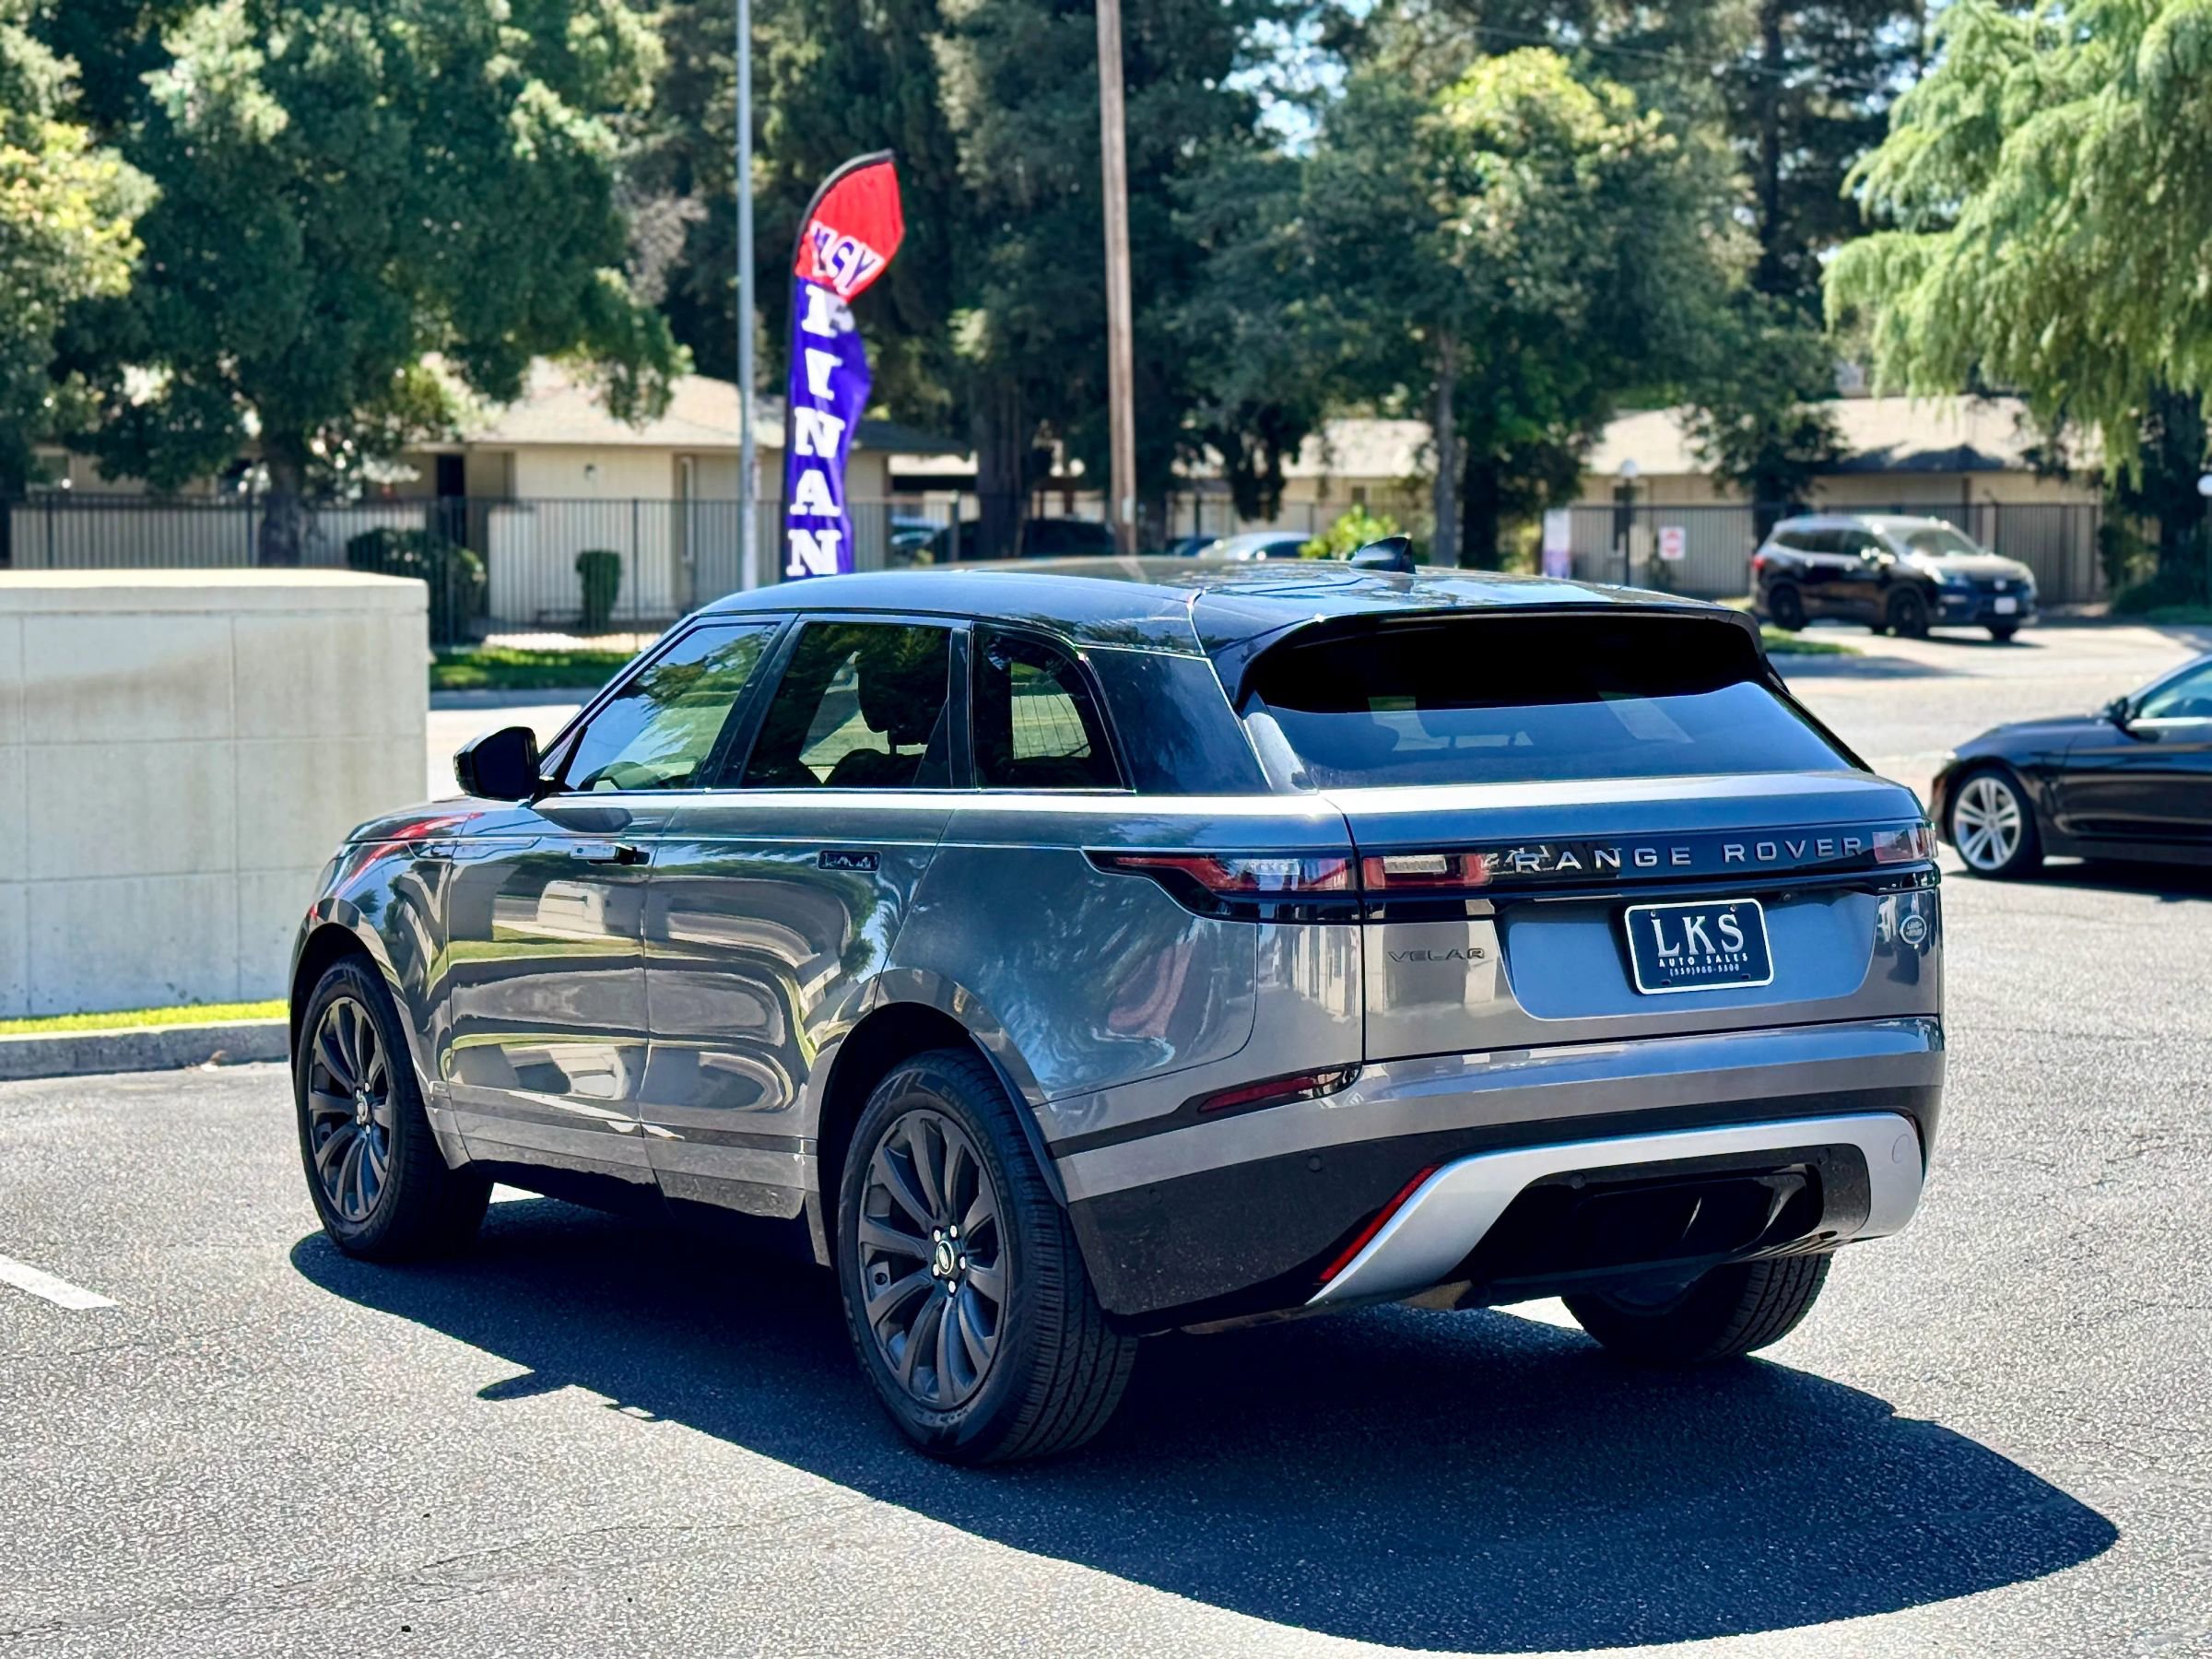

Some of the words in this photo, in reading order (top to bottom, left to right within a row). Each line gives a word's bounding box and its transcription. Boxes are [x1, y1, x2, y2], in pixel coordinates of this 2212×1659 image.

[1513, 845, 1692, 876] RANGE
[1723, 836, 1864, 865] ROVER
[1651, 913, 1745, 959] LKS
[1387, 947, 1486, 963] VELAR
[1659, 956, 1696, 968] AUTO
[1706, 952, 1748, 965] SALES
